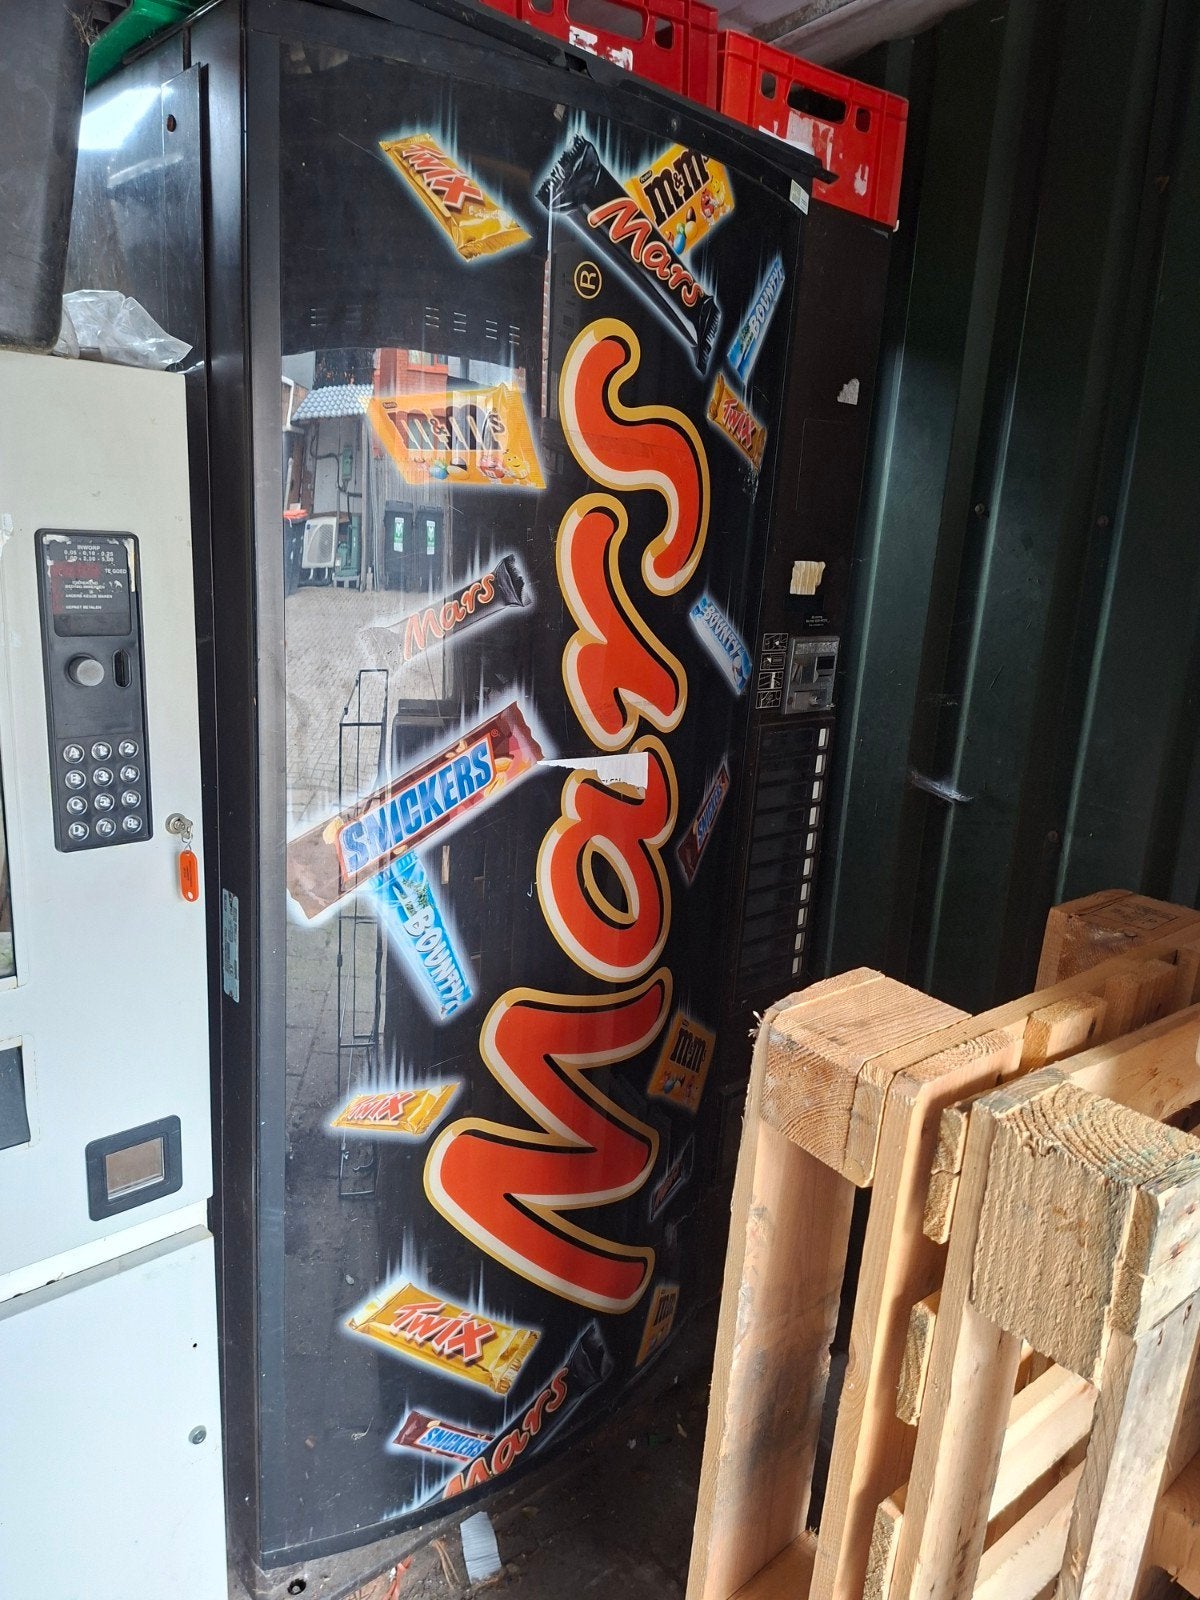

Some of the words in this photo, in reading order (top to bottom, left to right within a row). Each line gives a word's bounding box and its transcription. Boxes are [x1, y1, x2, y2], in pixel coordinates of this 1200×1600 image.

[587, 197, 704, 307] Mars
[404, 573, 495, 661] Mars
[704, 604, 742, 657] BOUNTY
[98, 771, 108, 781] 3
[126, 768, 135, 778] 4
[125, 743, 134, 753] 2
[100, 796, 109, 806] 5
[127, 793, 136, 803] 6
[128, 818, 137, 827] 8
[341, 740, 494, 876] SNICKERS
[421, 317, 711, 1314] Mars
[403, 906, 465, 1001] BOUNTY
[421, 1427, 489, 1458] SNICKERS
